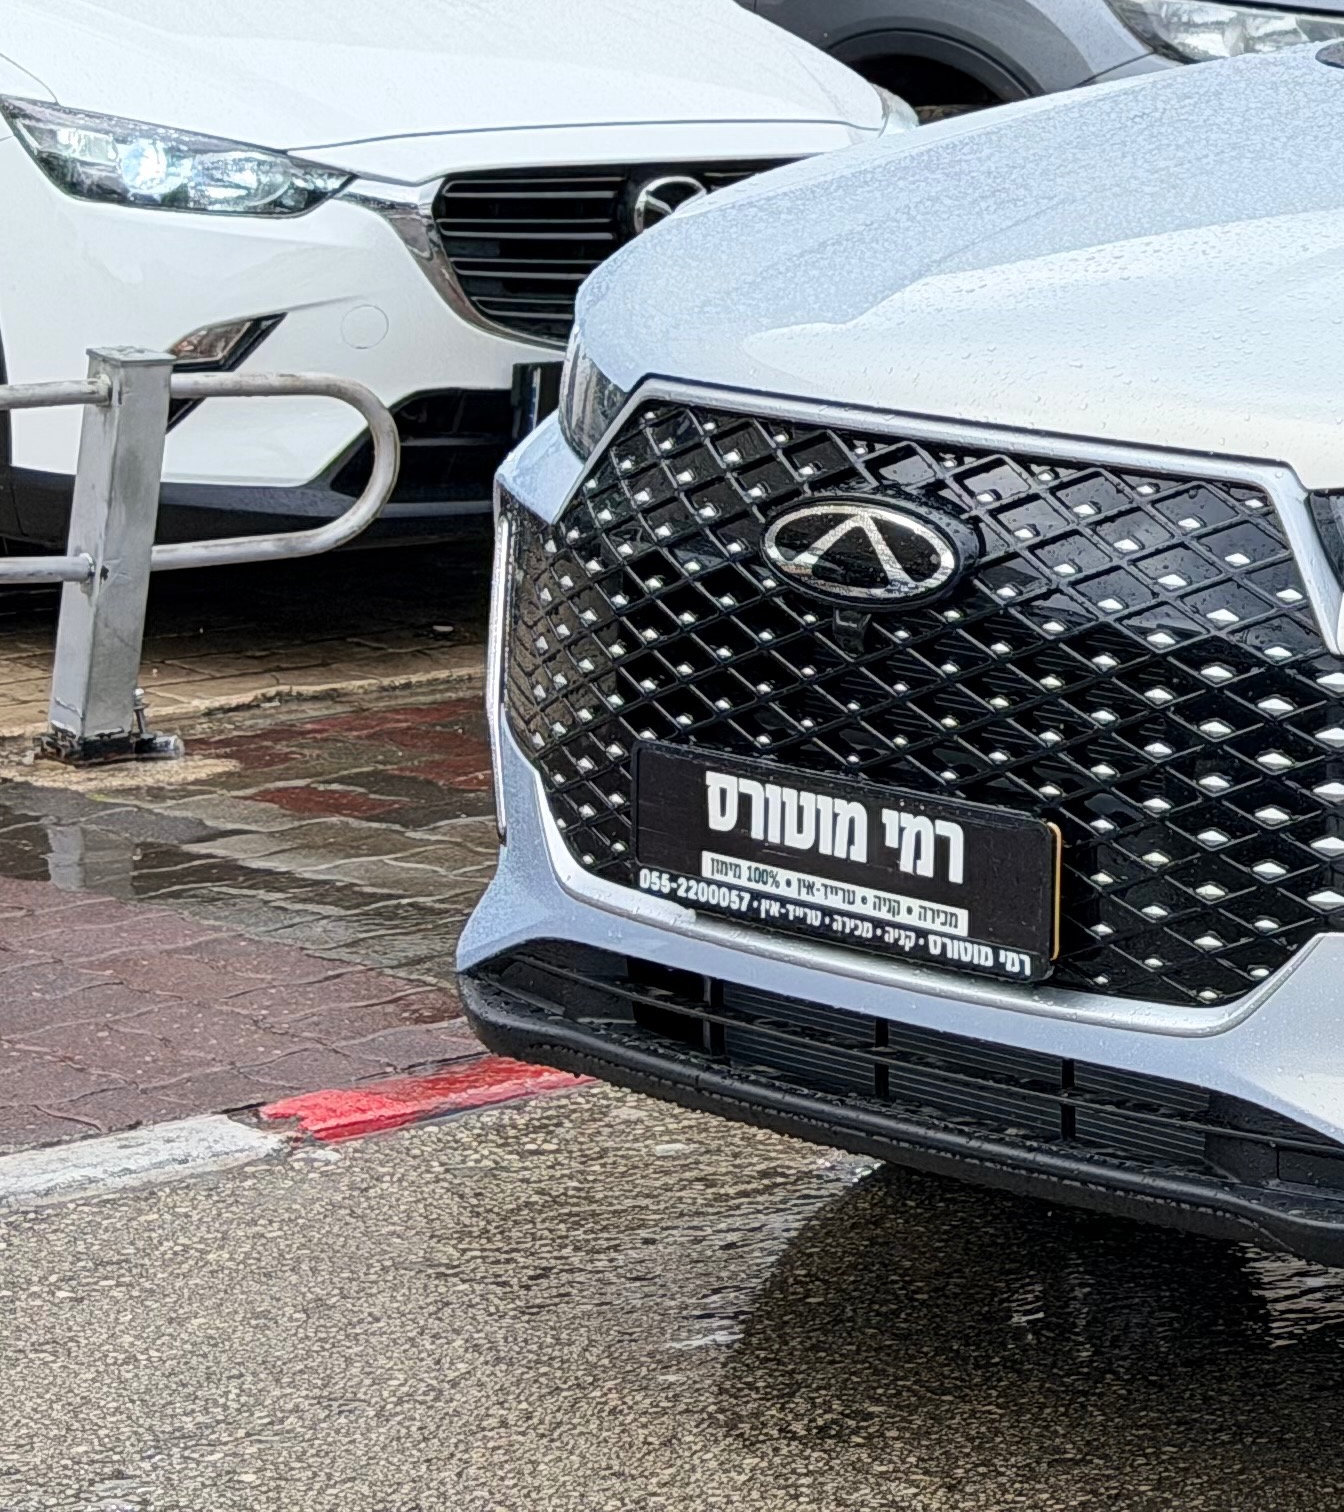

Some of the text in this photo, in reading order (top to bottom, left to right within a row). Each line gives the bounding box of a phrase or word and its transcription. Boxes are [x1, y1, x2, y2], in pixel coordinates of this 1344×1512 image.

[705, 770, 964, 885] רמי מוטורס
[711, 857, 741, 880] מימון
[747, 864, 780, 889] 100%
[639, 868, 751, 912] 055-2200057
[873, 894, 901, 918] קניה
[918, 904, 958, 929] מכירה
[832, 914, 873, 939] מכירה
[883, 926, 916, 952] קניה
[927, 934, 994, 967] מוטורס
[998, 949, 1031, 976] רמי
